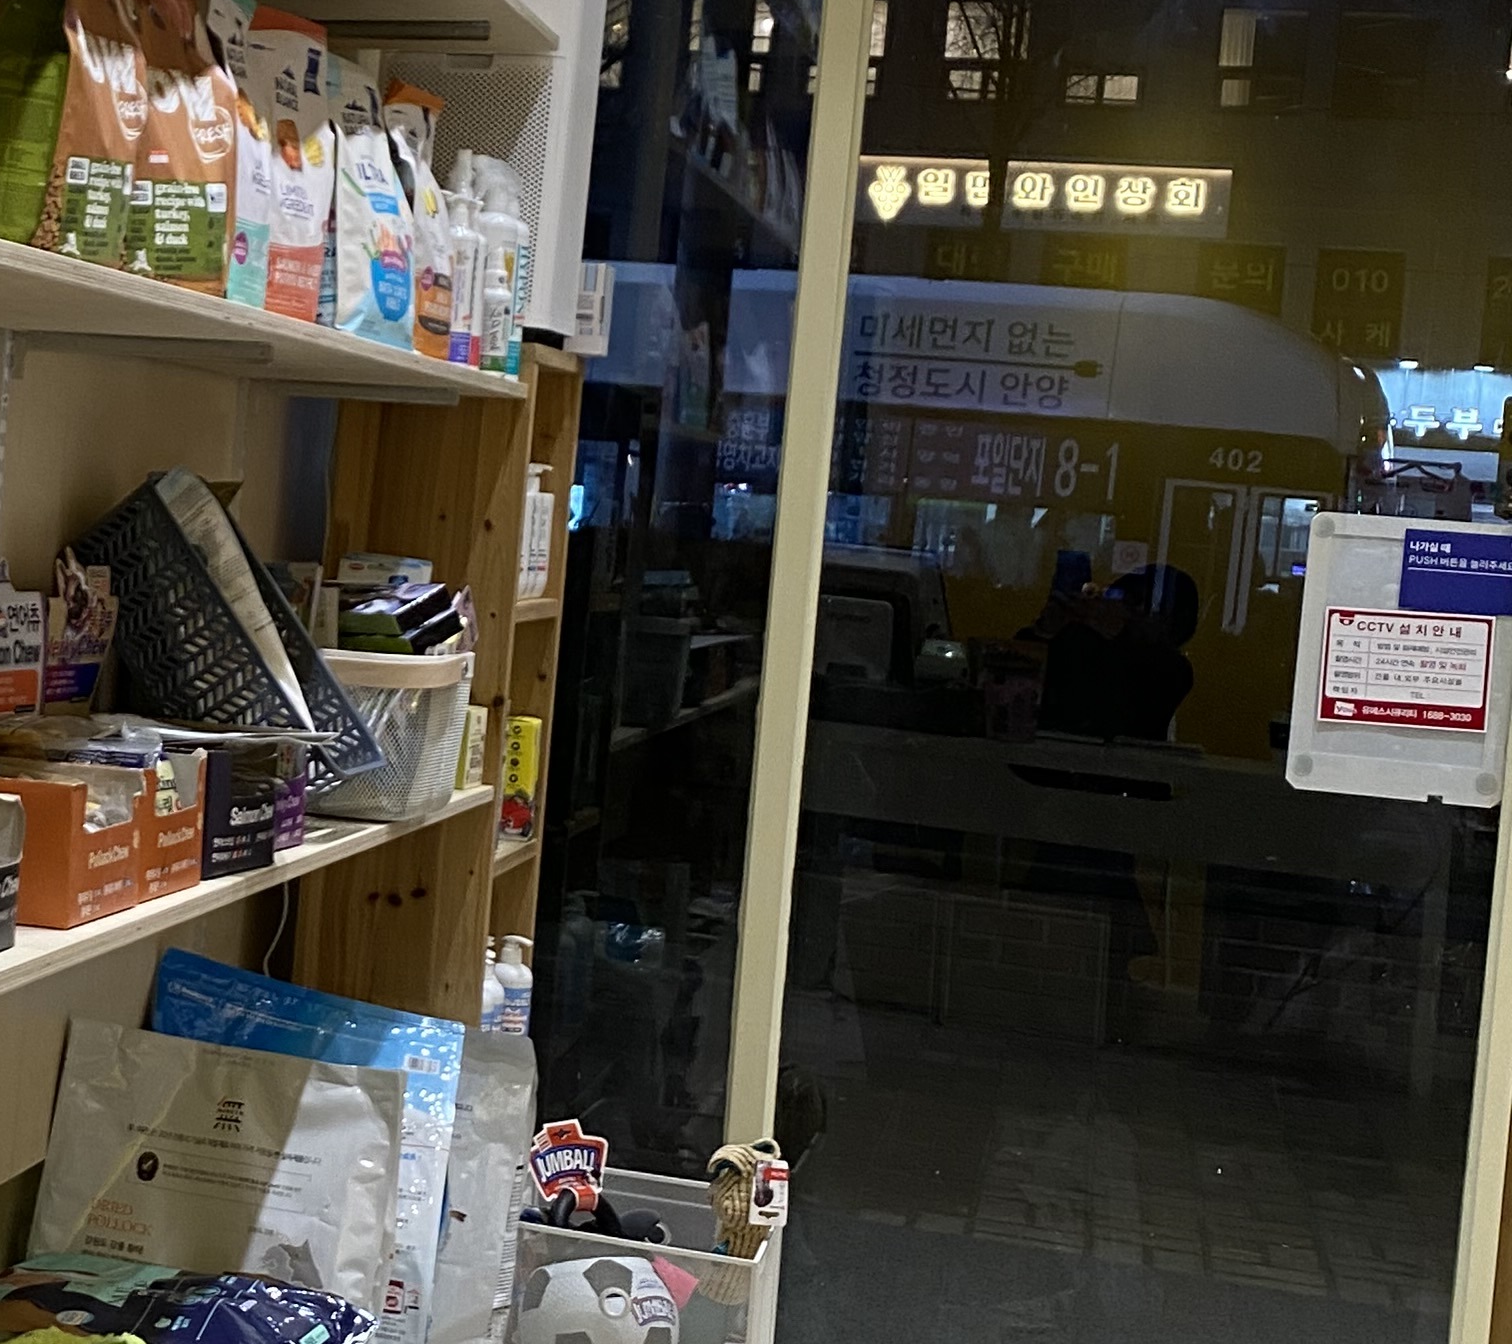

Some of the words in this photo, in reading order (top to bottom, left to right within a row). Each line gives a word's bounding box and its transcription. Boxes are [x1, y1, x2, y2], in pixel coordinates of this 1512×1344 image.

[1332, 267, 1389, 293] 010
[859, 313, 996, 354] 미세먼지
[1006, 319, 1076, 358] 없는
[854, 360, 987, 404] 청정도시
[999, 370, 1071, 410] 안양
[1053, 437, 1120, 502] 8-1
[1208, 446, 1264, 474] 402
[1408, 554, 1438, 566] PUSH
[1409, 540, 1439, 554] 나가실
[1440, 542, 1452, 554] 때
[1357, 621, 1395, 634] CCTV
